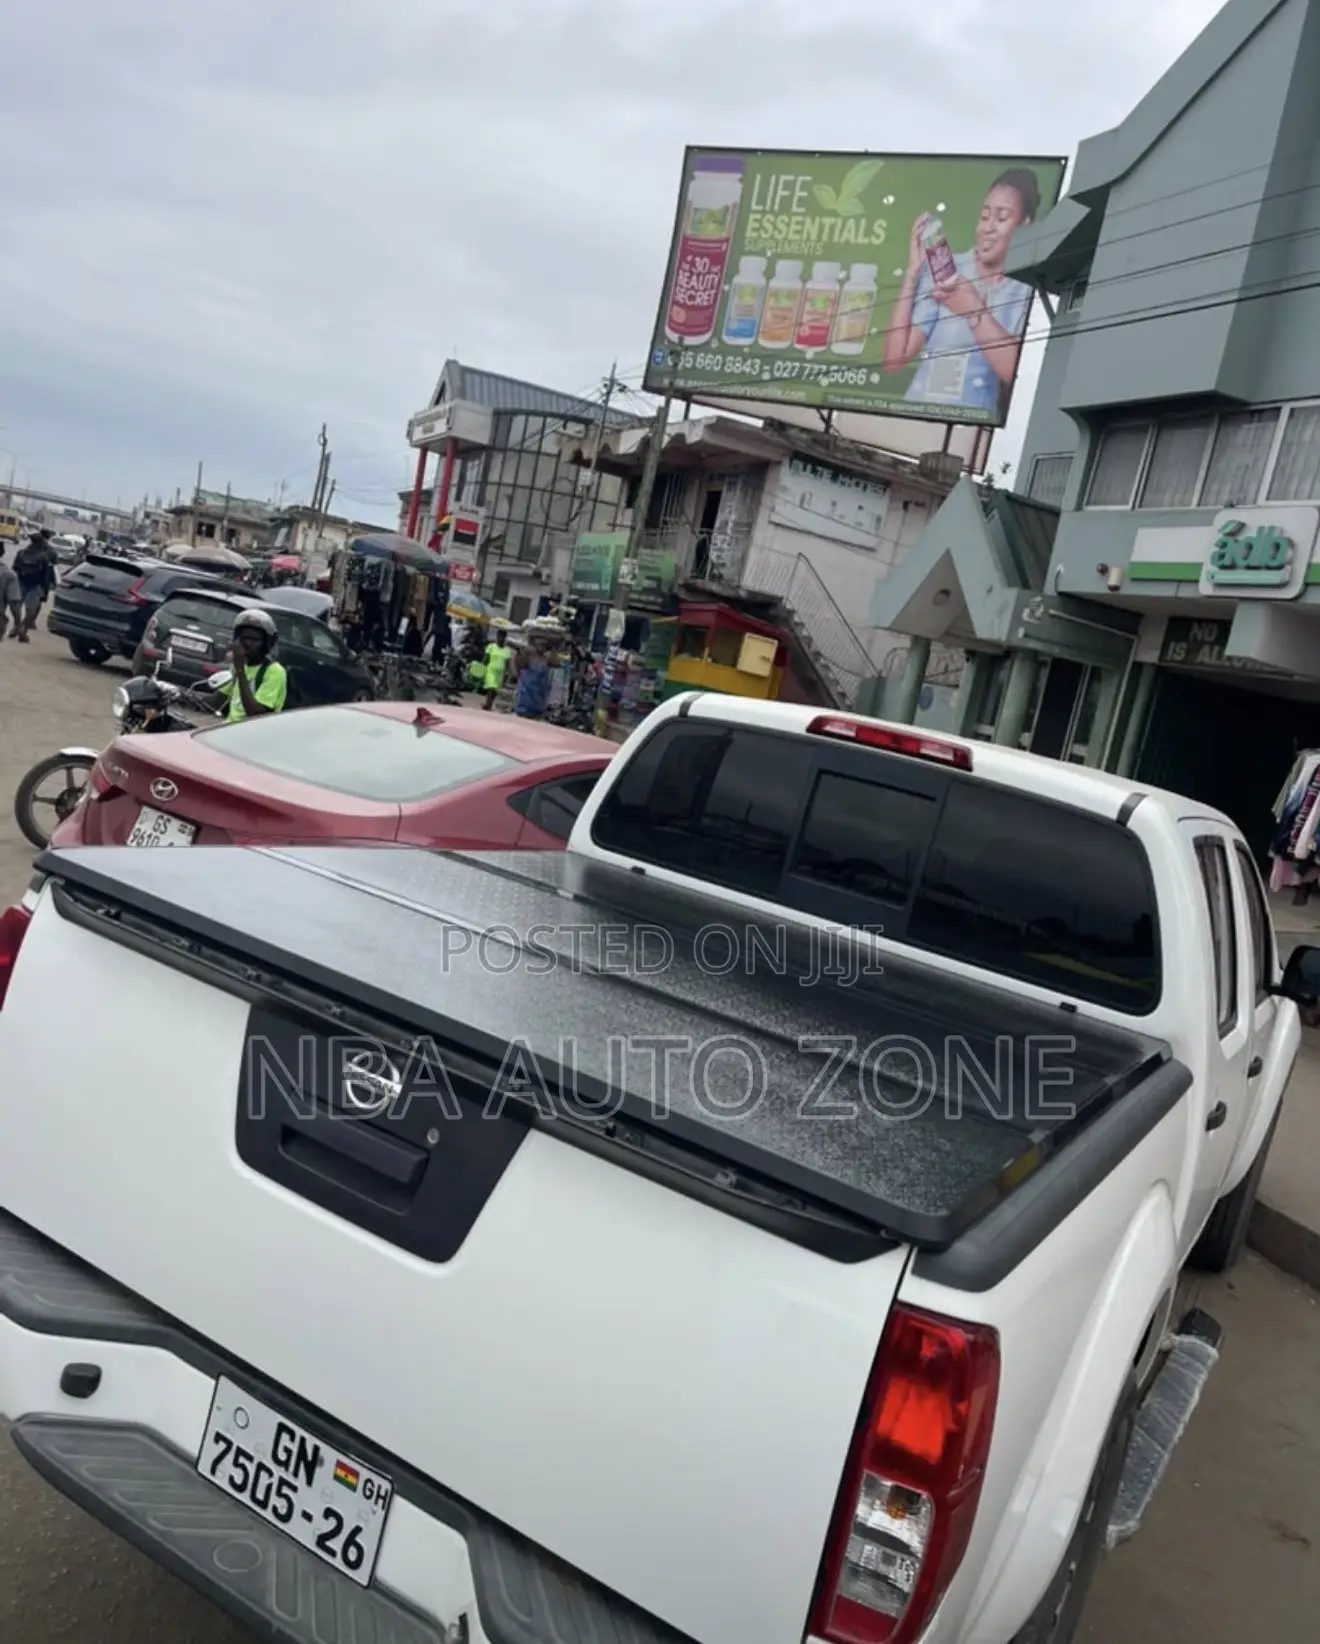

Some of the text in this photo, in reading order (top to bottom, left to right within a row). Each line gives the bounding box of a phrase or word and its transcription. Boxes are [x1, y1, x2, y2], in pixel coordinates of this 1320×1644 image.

[750, 174, 812, 212] LIFE
[744, 213, 887, 245] ESSENTIALS
[1209, 525, 1294, 570] adb
[1189, 621, 1218, 642] NO
[1165, 641, 1187, 661] IS
[271, 1421, 389, 1511] GN GH
[209, 1430, 365, 1571] 7505-26
